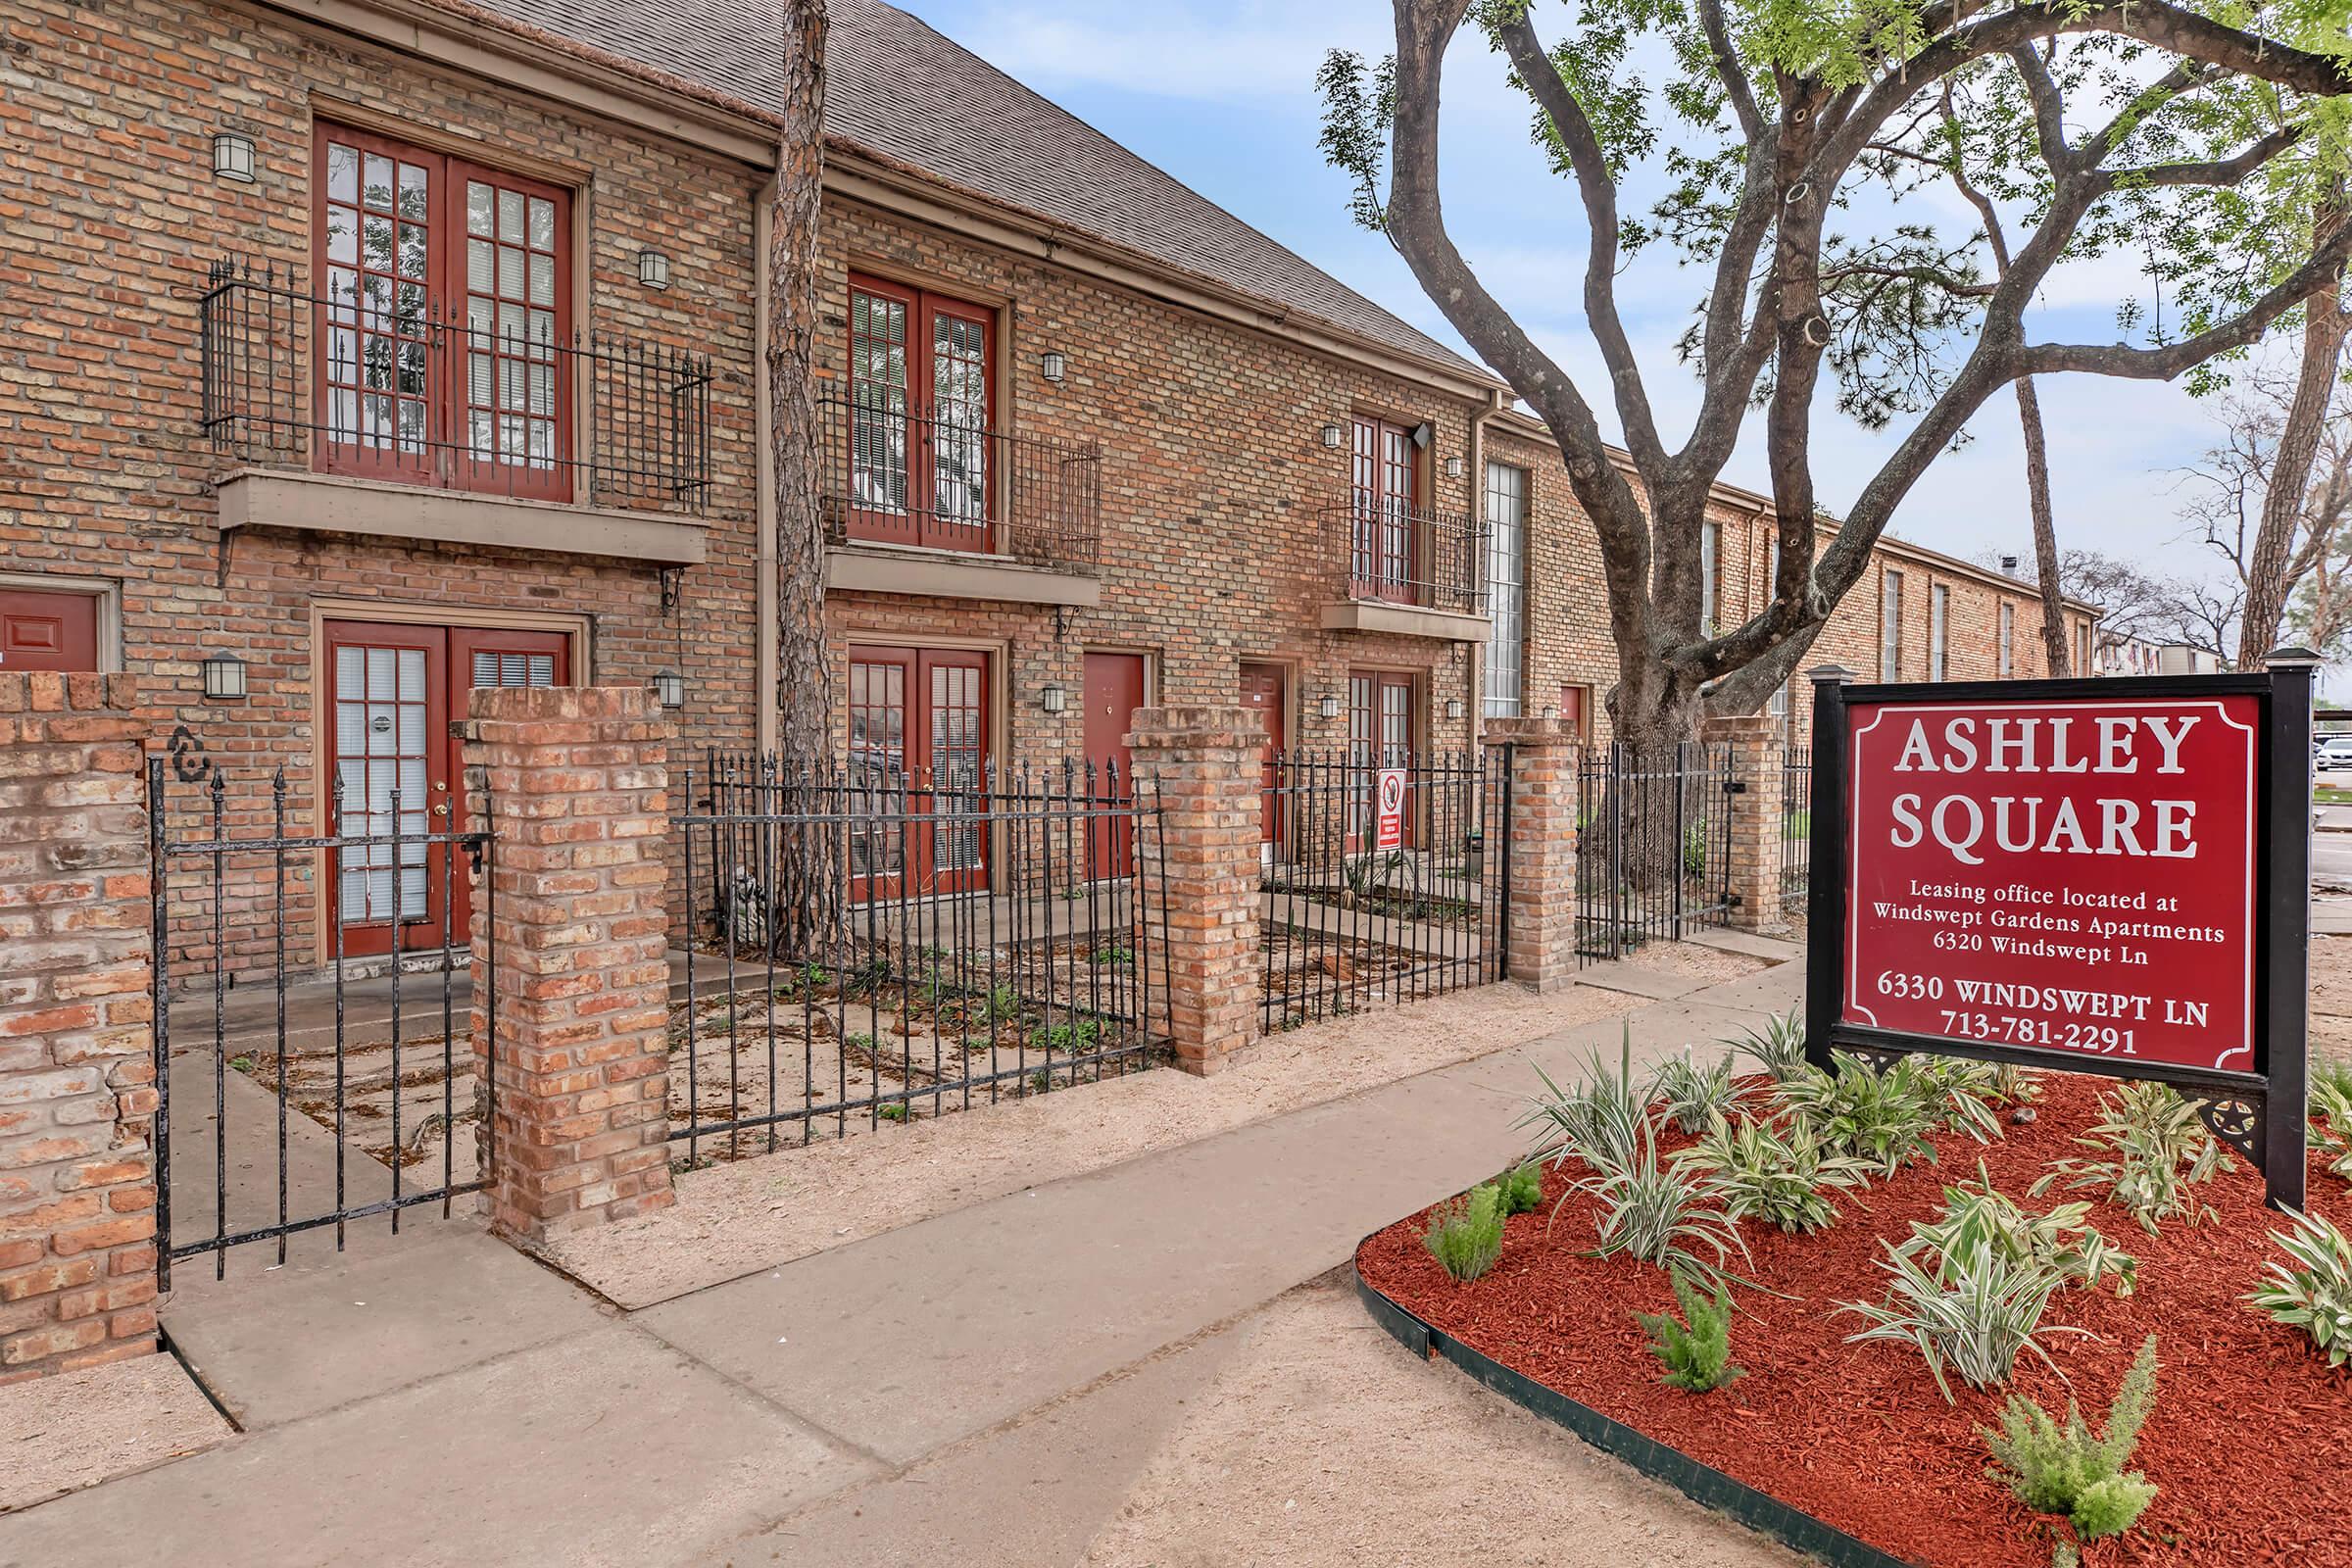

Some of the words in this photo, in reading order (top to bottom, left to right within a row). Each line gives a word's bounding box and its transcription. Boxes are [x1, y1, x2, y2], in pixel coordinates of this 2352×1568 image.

[1892, 715, 2202, 774] ASHLEY
[1890, 793, 2198, 865] SQUARE
[1909, 879, 1986, 905] Leasing
[1993, 884, 2054, 905] office
[2062, 887, 2147, 911] located
[2156, 897, 2179, 912] at
[1873, 902, 1983, 929] Windswept
[1990, 909, 2081, 933] Gardens
[2087, 917, 2226, 943] Apartments
[1933, 930, 1983, 952] 6320
[1990, 935, 2112, 965] Windswept
[2120, 946, 2149, 965] Ln
[1877, 969, 1944, 1001] 6330
[1953, 979, 2152, 1021] WINDSWEPT
[2163, 999, 2210, 1028] LN
[1939, 1009, 2137, 1054] 713-781-2291
